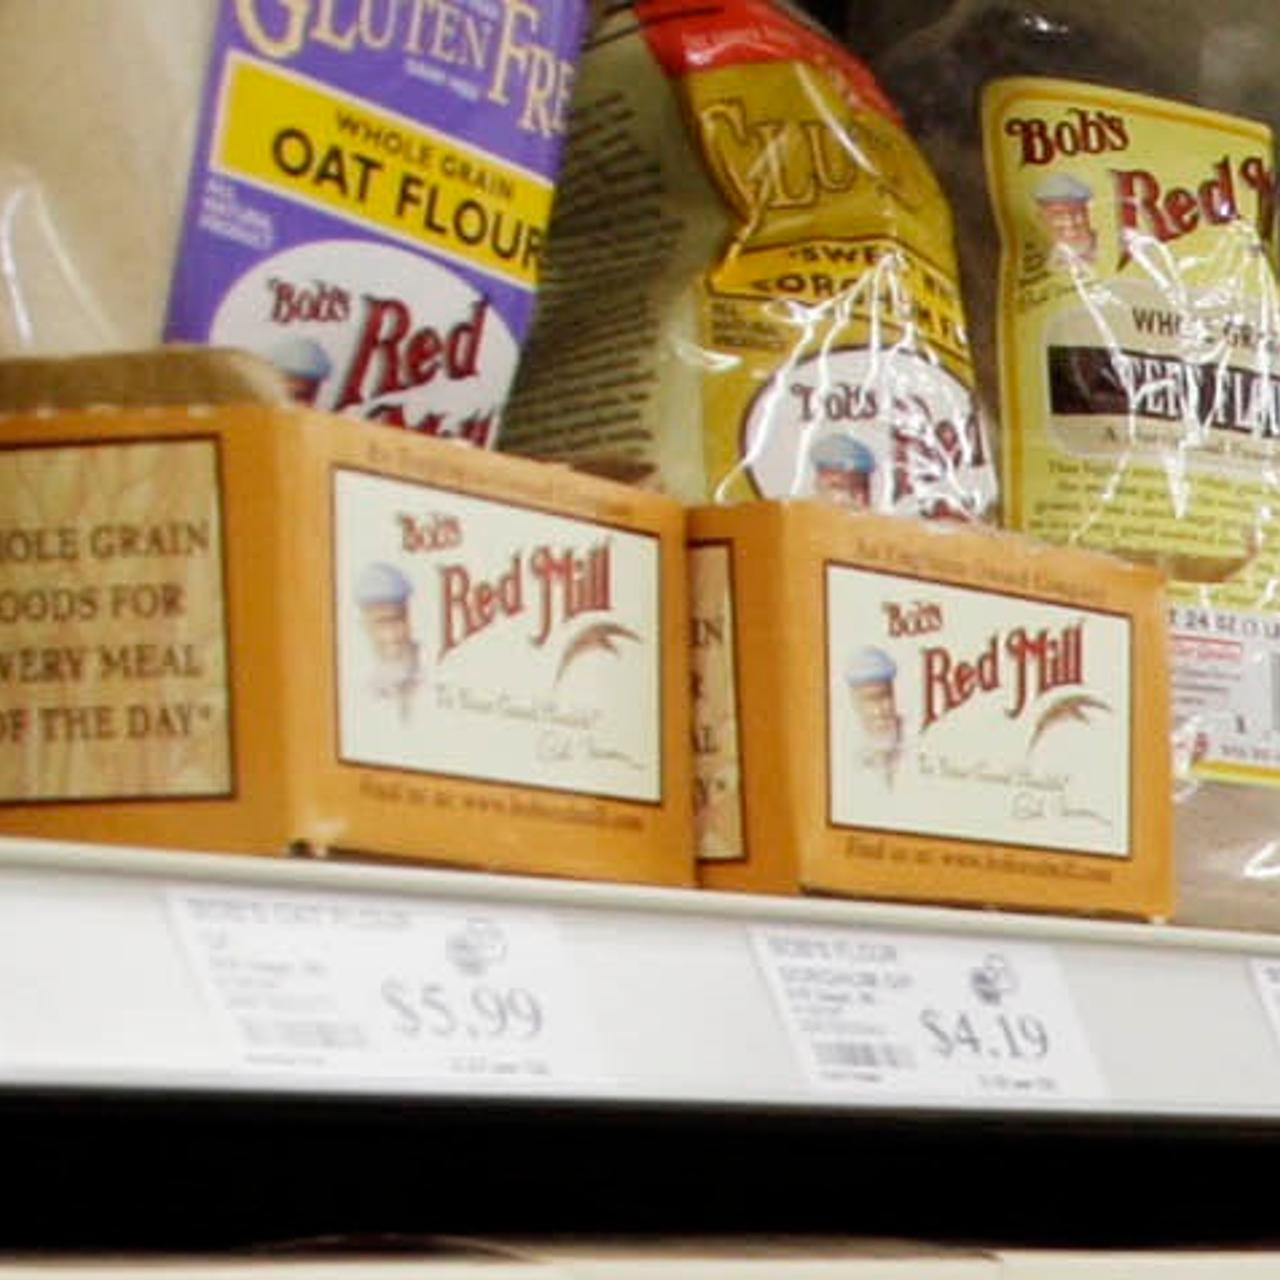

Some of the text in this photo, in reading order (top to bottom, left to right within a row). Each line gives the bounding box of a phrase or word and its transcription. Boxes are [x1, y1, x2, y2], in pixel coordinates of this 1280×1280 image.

[270, 127, 384, 202] OAT
[335, 109, 516, 199] WHOLE GRAIN
[1005, 110, 1130, 165] Bob's
[1110, 154, 1241, 269] Red
[336, 291, 491, 412] Red
[89, 519, 210, 558] GRAIN
[111, 586, 186, 620] FOR
[436, 536, 618, 662] Red Mill
[102, 642, 202, 679] MEAL
[920, 619, 1088, 732] Red Mill
[381, 980, 544, 1041] $5.99
[918, 1008, 1050, 1062] $4.19
